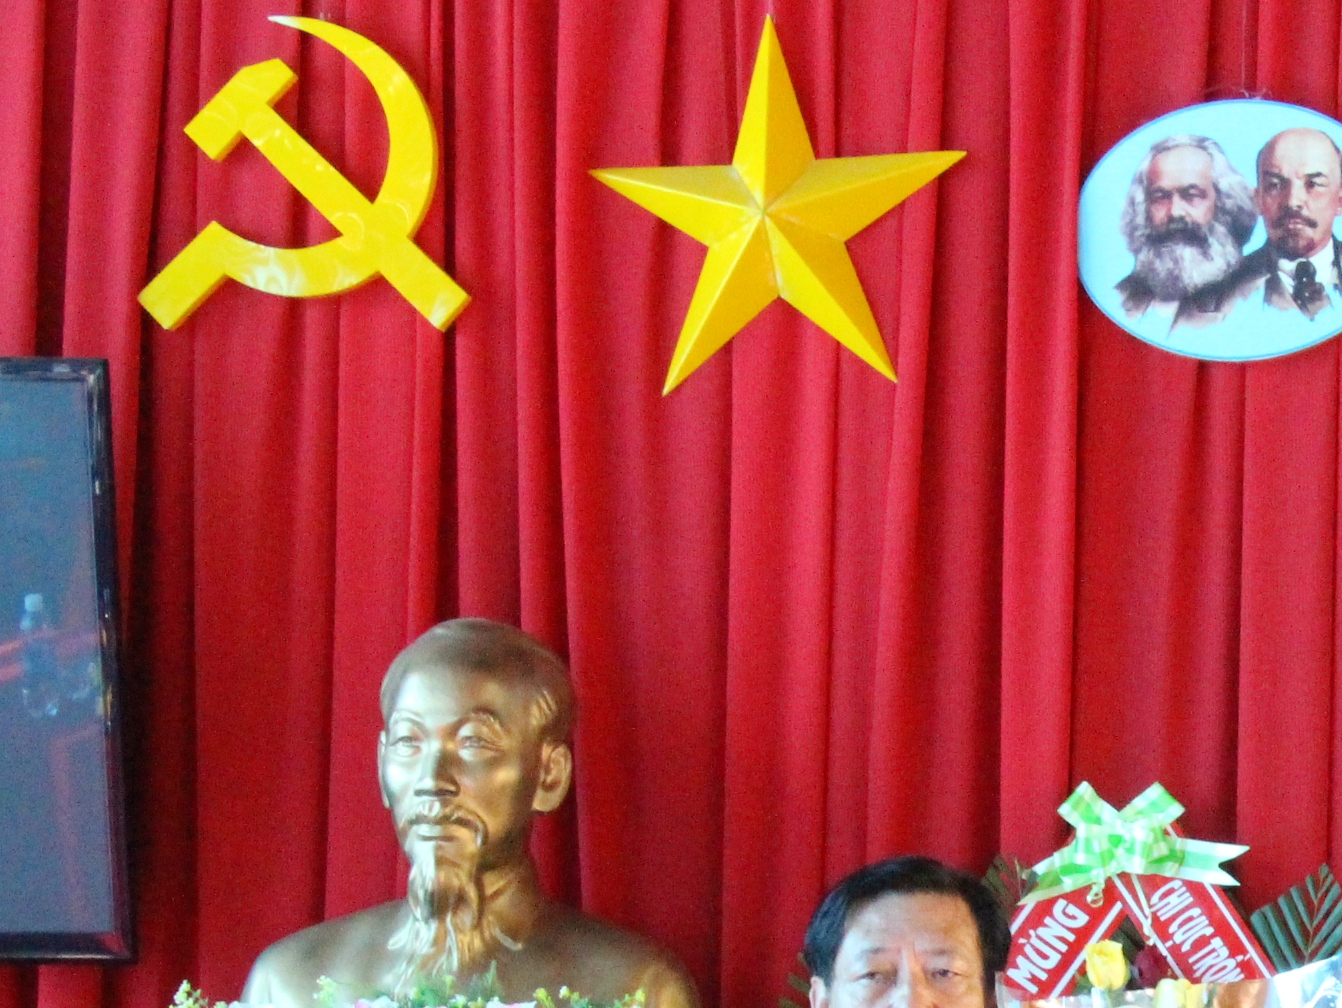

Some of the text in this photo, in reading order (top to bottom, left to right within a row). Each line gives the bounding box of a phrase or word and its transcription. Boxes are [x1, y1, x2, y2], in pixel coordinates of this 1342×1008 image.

[1149, 879, 1194, 922] CHI
[1006, 898, 1090, 995] MỪNG
[1164, 907, 1215, 953] CỤC
